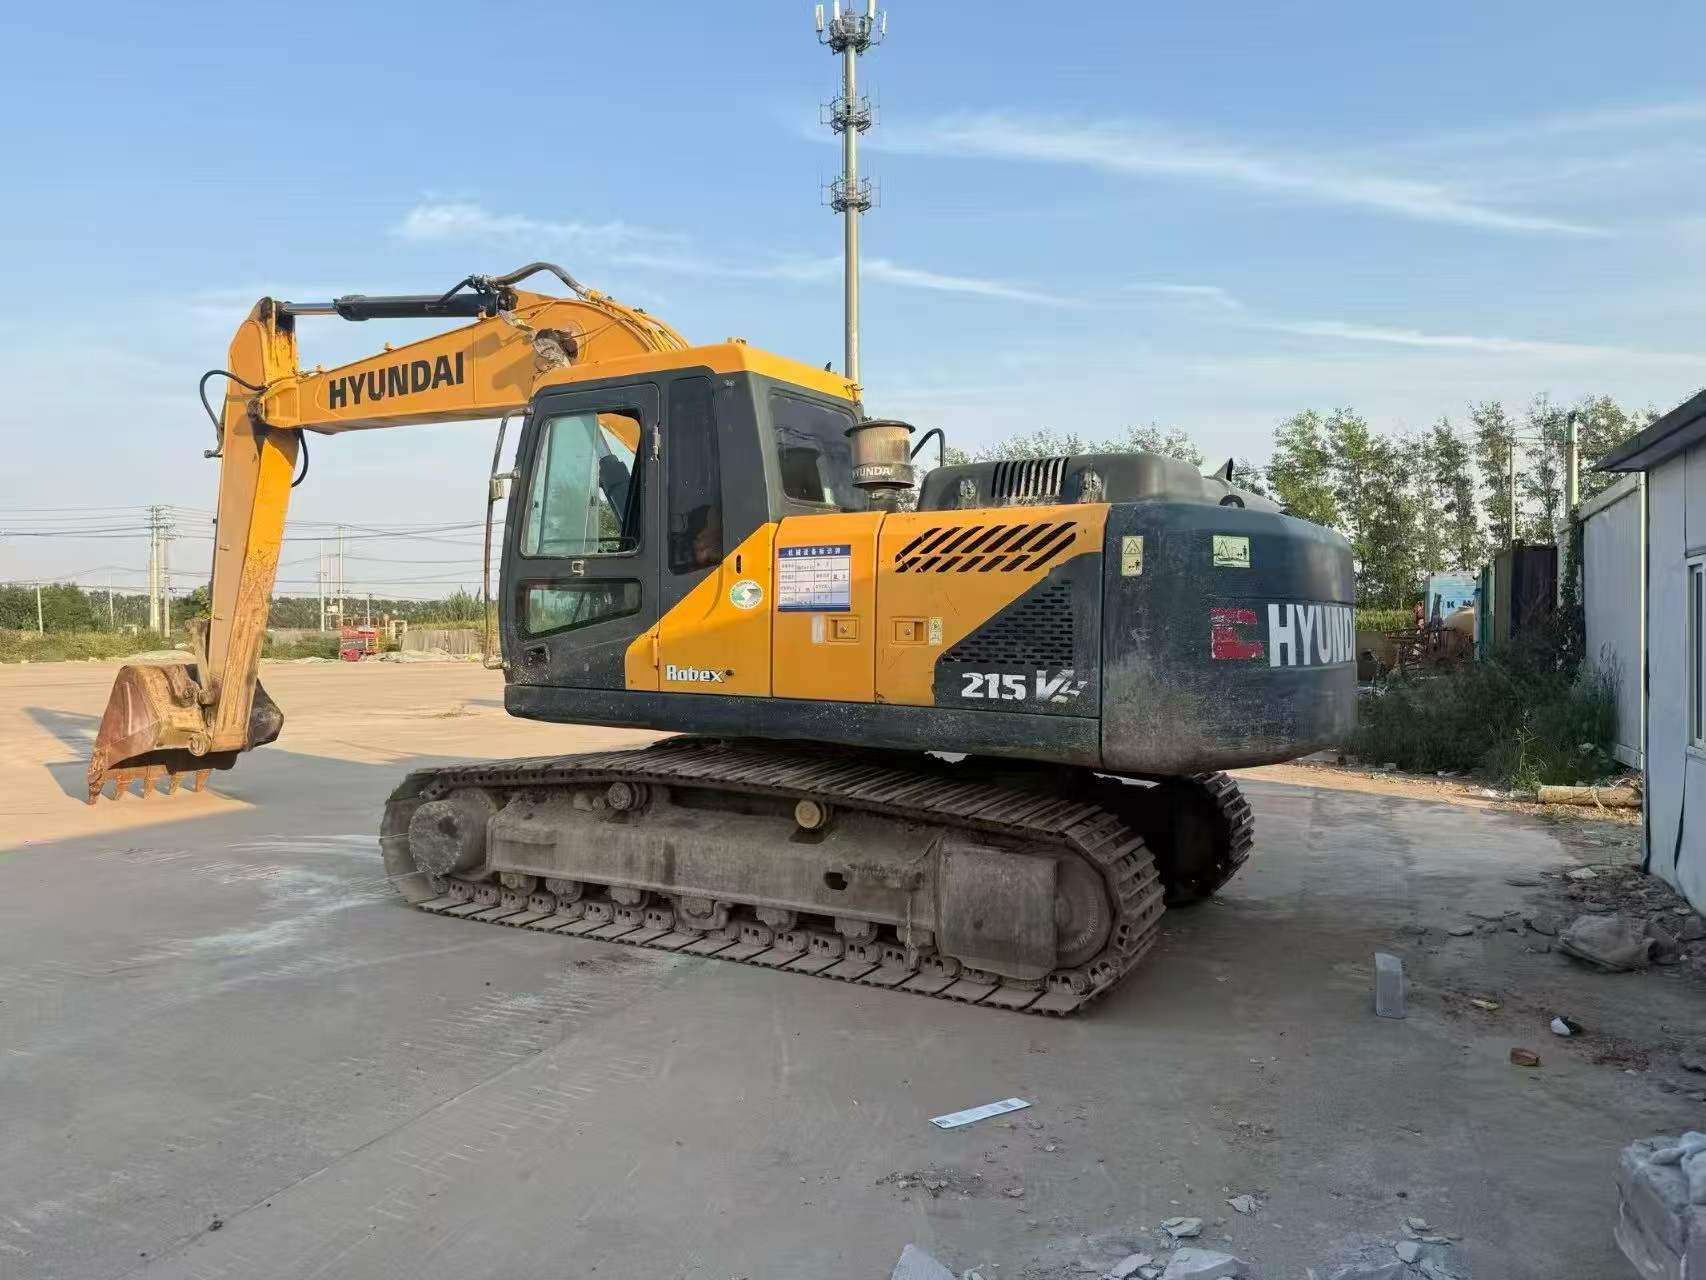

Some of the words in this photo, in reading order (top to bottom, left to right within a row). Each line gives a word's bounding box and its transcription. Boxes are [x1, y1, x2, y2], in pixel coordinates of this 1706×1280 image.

[329, 351, 464, 410] HYUNDAI
[1268, 603, 1356, 667] HYUND
[666, 664, 725, 683] Robex
[961, 672, 1026, 700] 215
